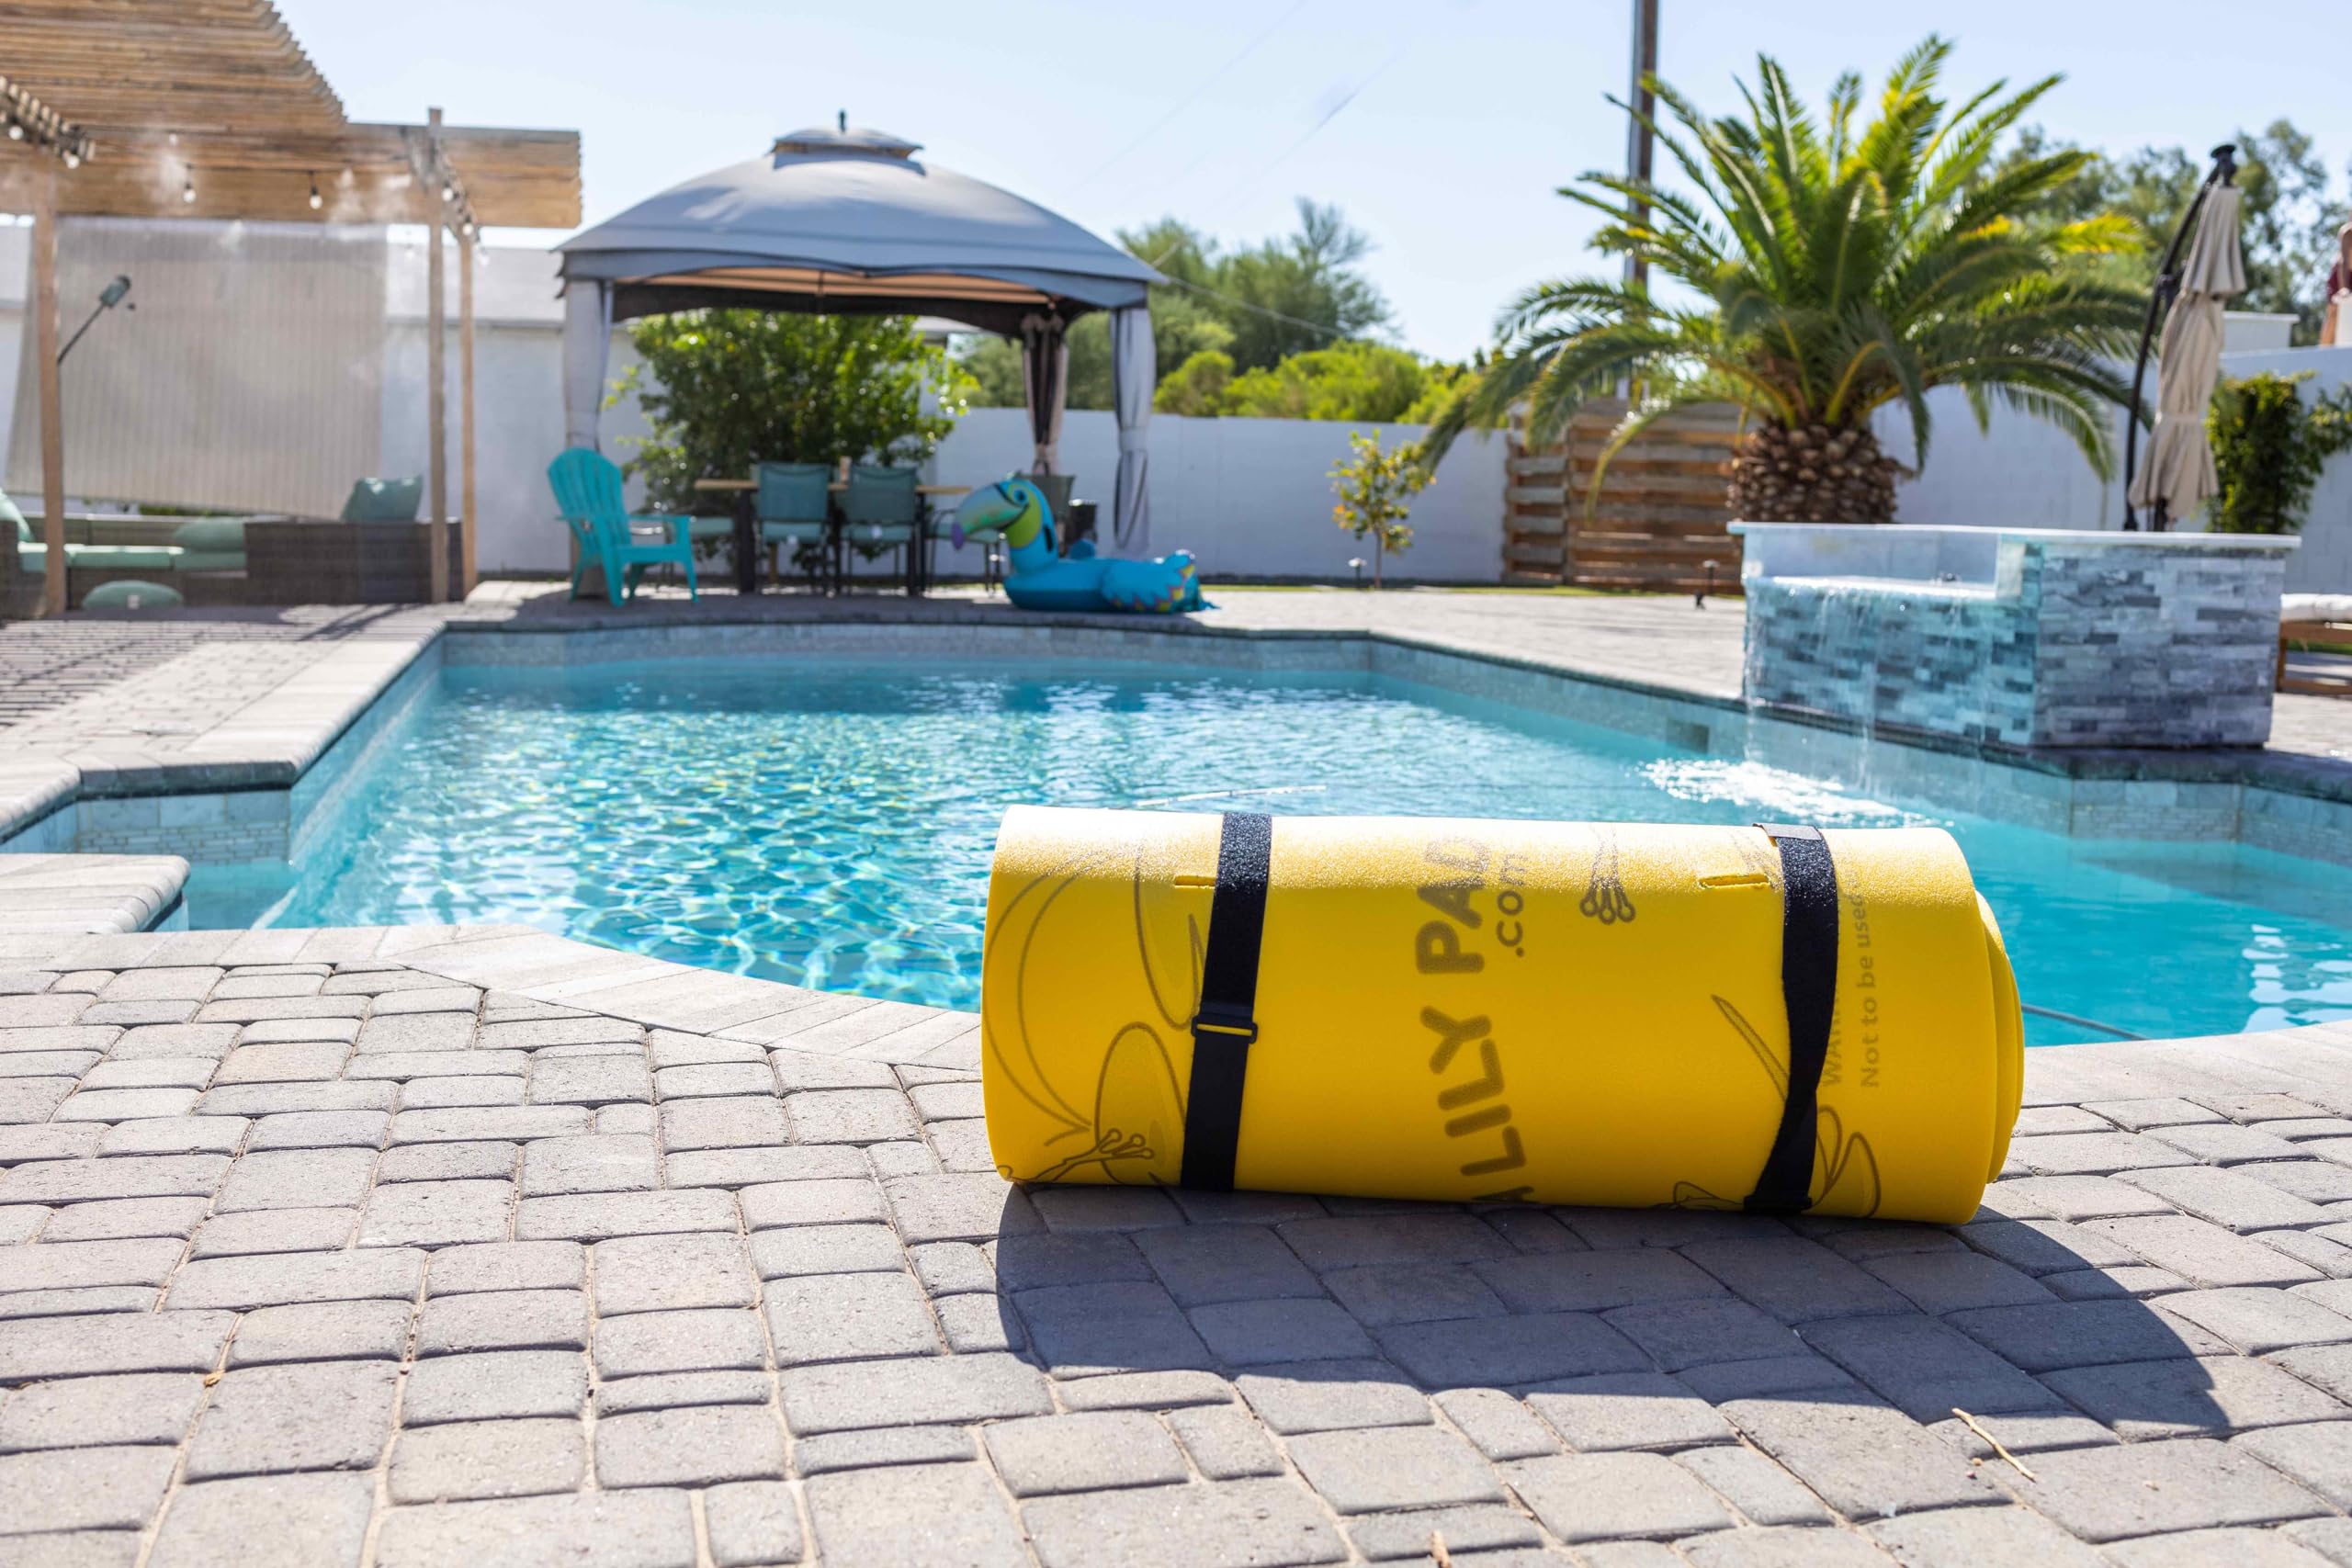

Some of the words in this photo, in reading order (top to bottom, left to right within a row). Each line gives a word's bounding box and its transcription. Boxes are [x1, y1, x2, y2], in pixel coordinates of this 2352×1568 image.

[1415, 837, 1490, 975] PAD
[1496, 852, 1526, 957] .com
[1849, 891, 1871, 949] used
[1856, 954, 1876, 988] be
[1860, 996, 1879, 1026] to
[1860, 1032, 1880, 1088] Not
[1419, 1005, 1527, 1177] LILY
